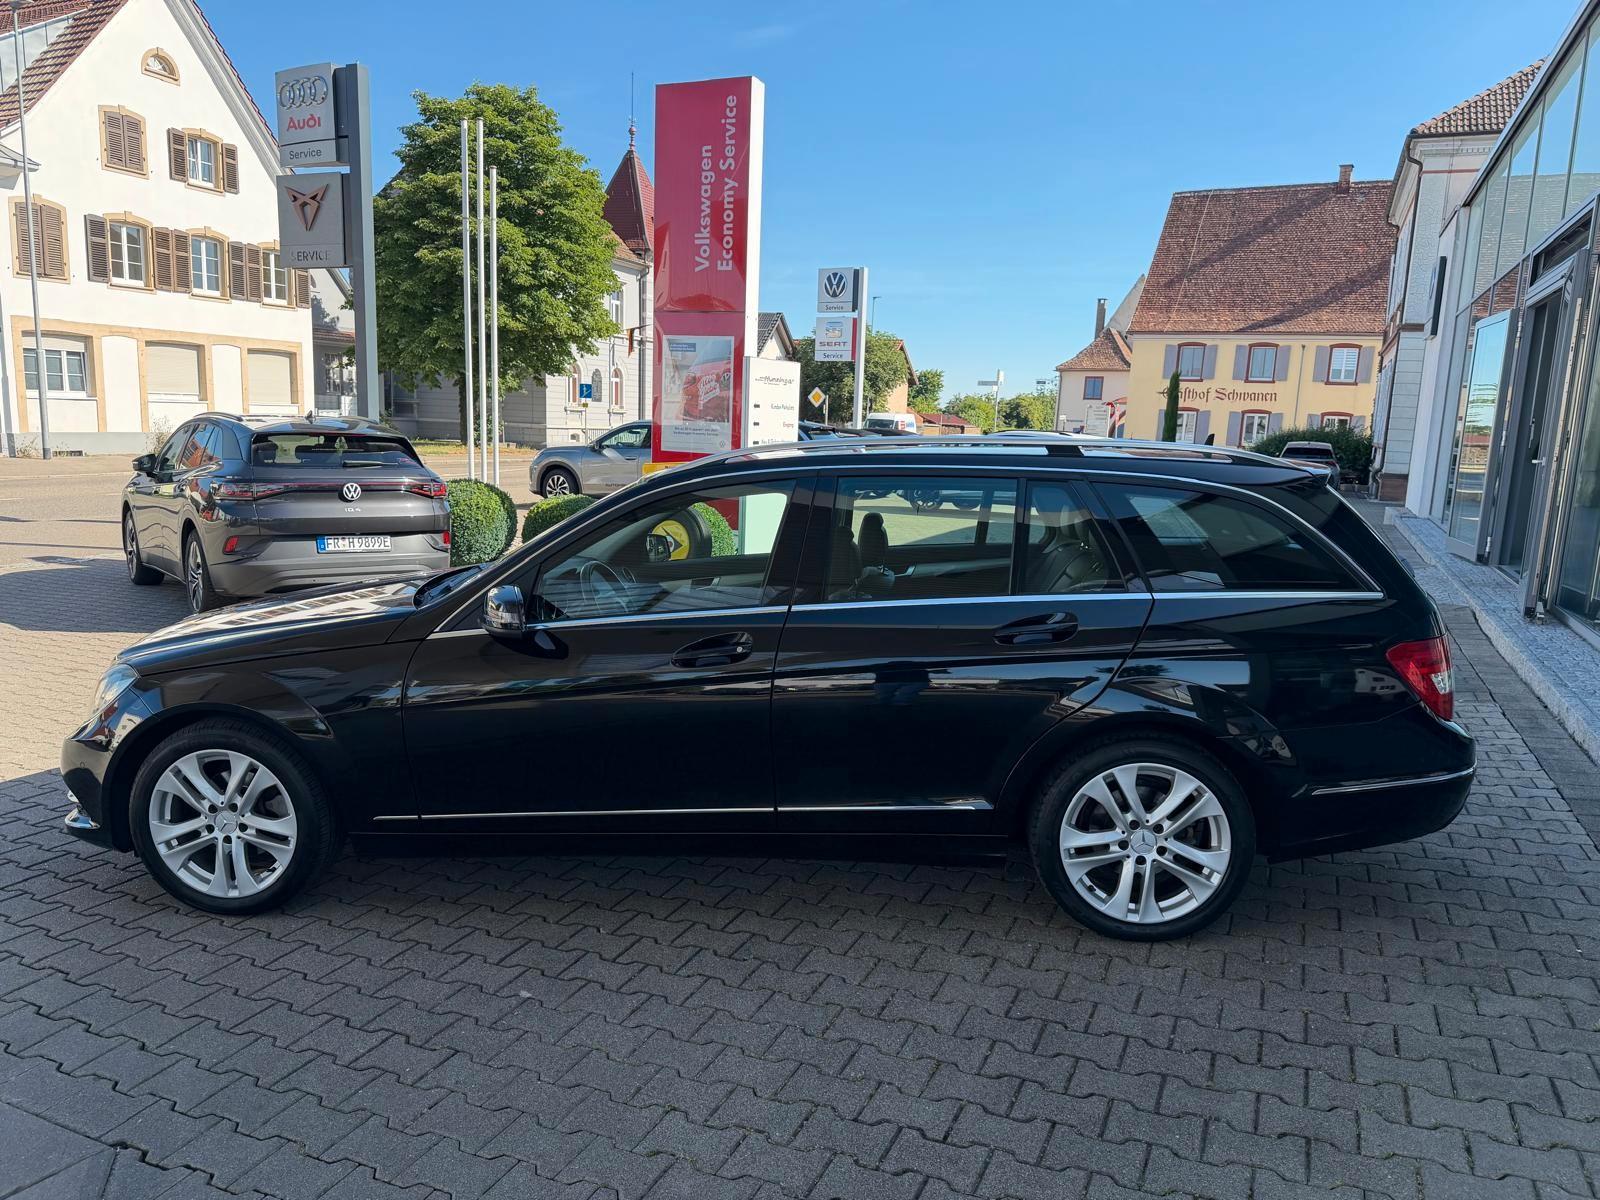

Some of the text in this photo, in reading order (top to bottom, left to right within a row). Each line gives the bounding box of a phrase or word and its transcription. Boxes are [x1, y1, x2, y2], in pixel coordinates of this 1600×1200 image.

[286, 114, 321, 132] Audi
[289, 148, 322, 160] Service
[717, 95, 739, 271] Economy Service
[694, 145, 715, 272] Volkswagen
[292, 251, 329, 262] SERVICE
[823, 352, 843, 360] Service
[1215, 388, 1277, 402] Schwanen
